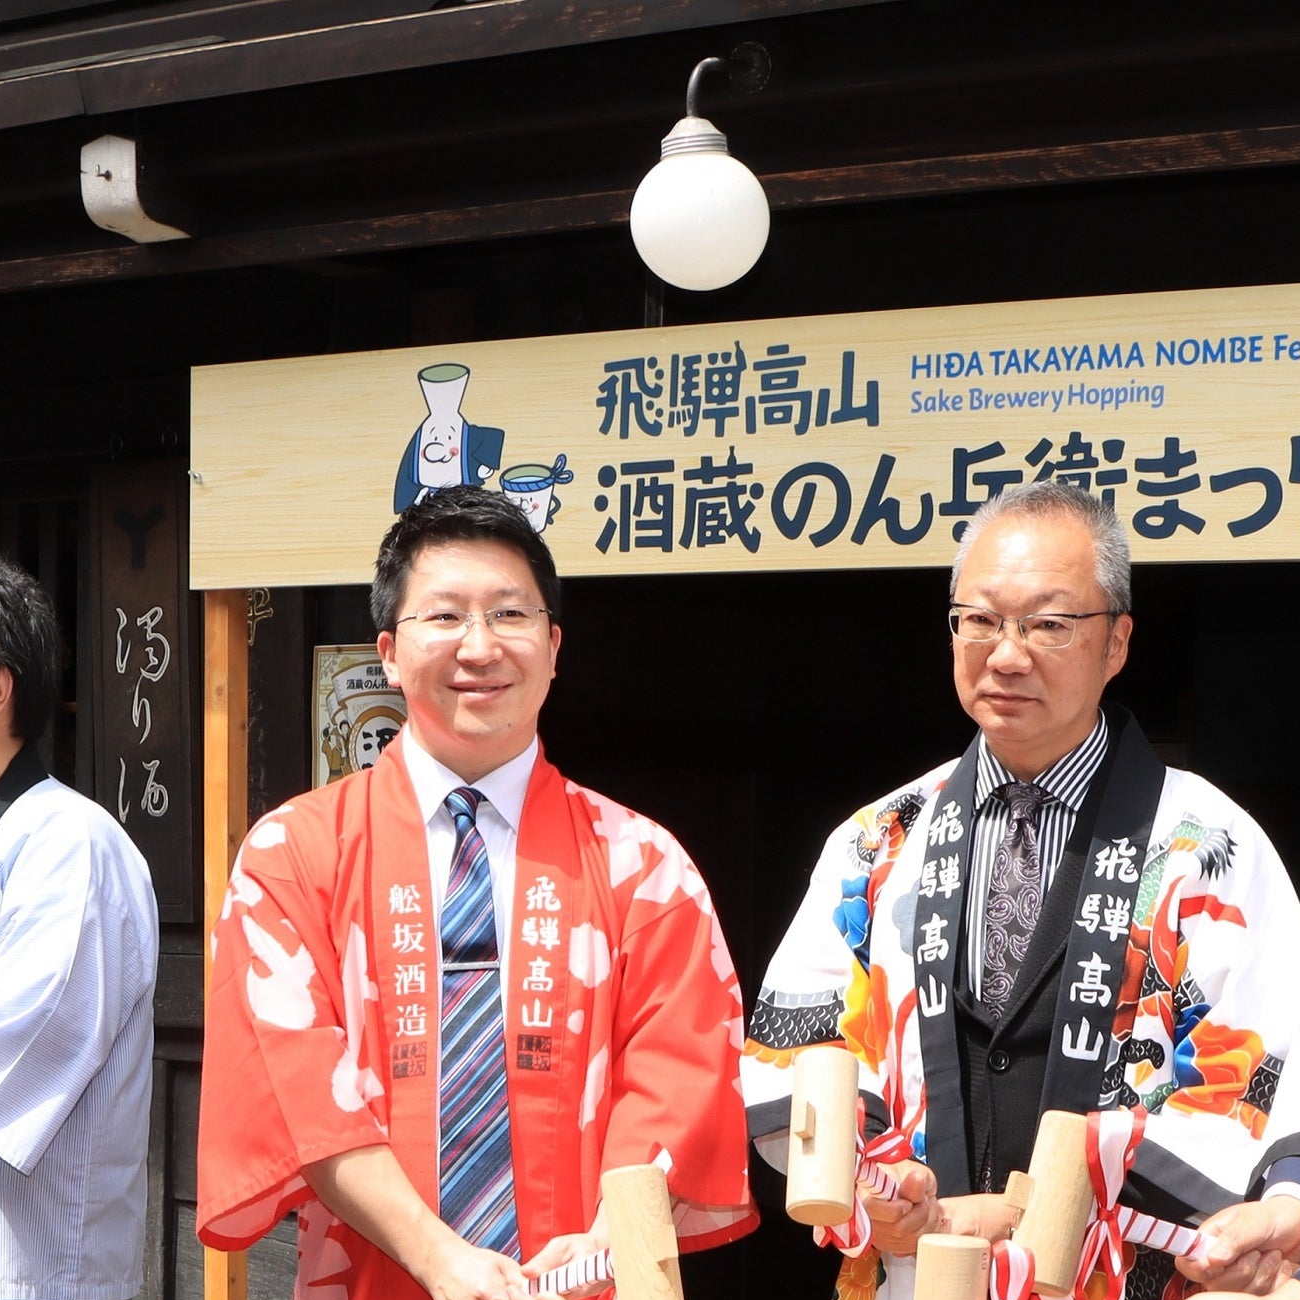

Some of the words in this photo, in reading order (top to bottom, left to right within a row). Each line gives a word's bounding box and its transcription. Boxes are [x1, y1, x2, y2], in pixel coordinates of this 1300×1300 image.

[989, 341, 1145, 376] TAKAYAMA
[1155, 335, 1264, 367] NOMBE
[595, 340, 880, 440] 飛騨高山
[910, 388, 964, 414] Sake
[968, 387, 1065, 413] Brewery
[1067, 378, 1165, 411] Hopping
